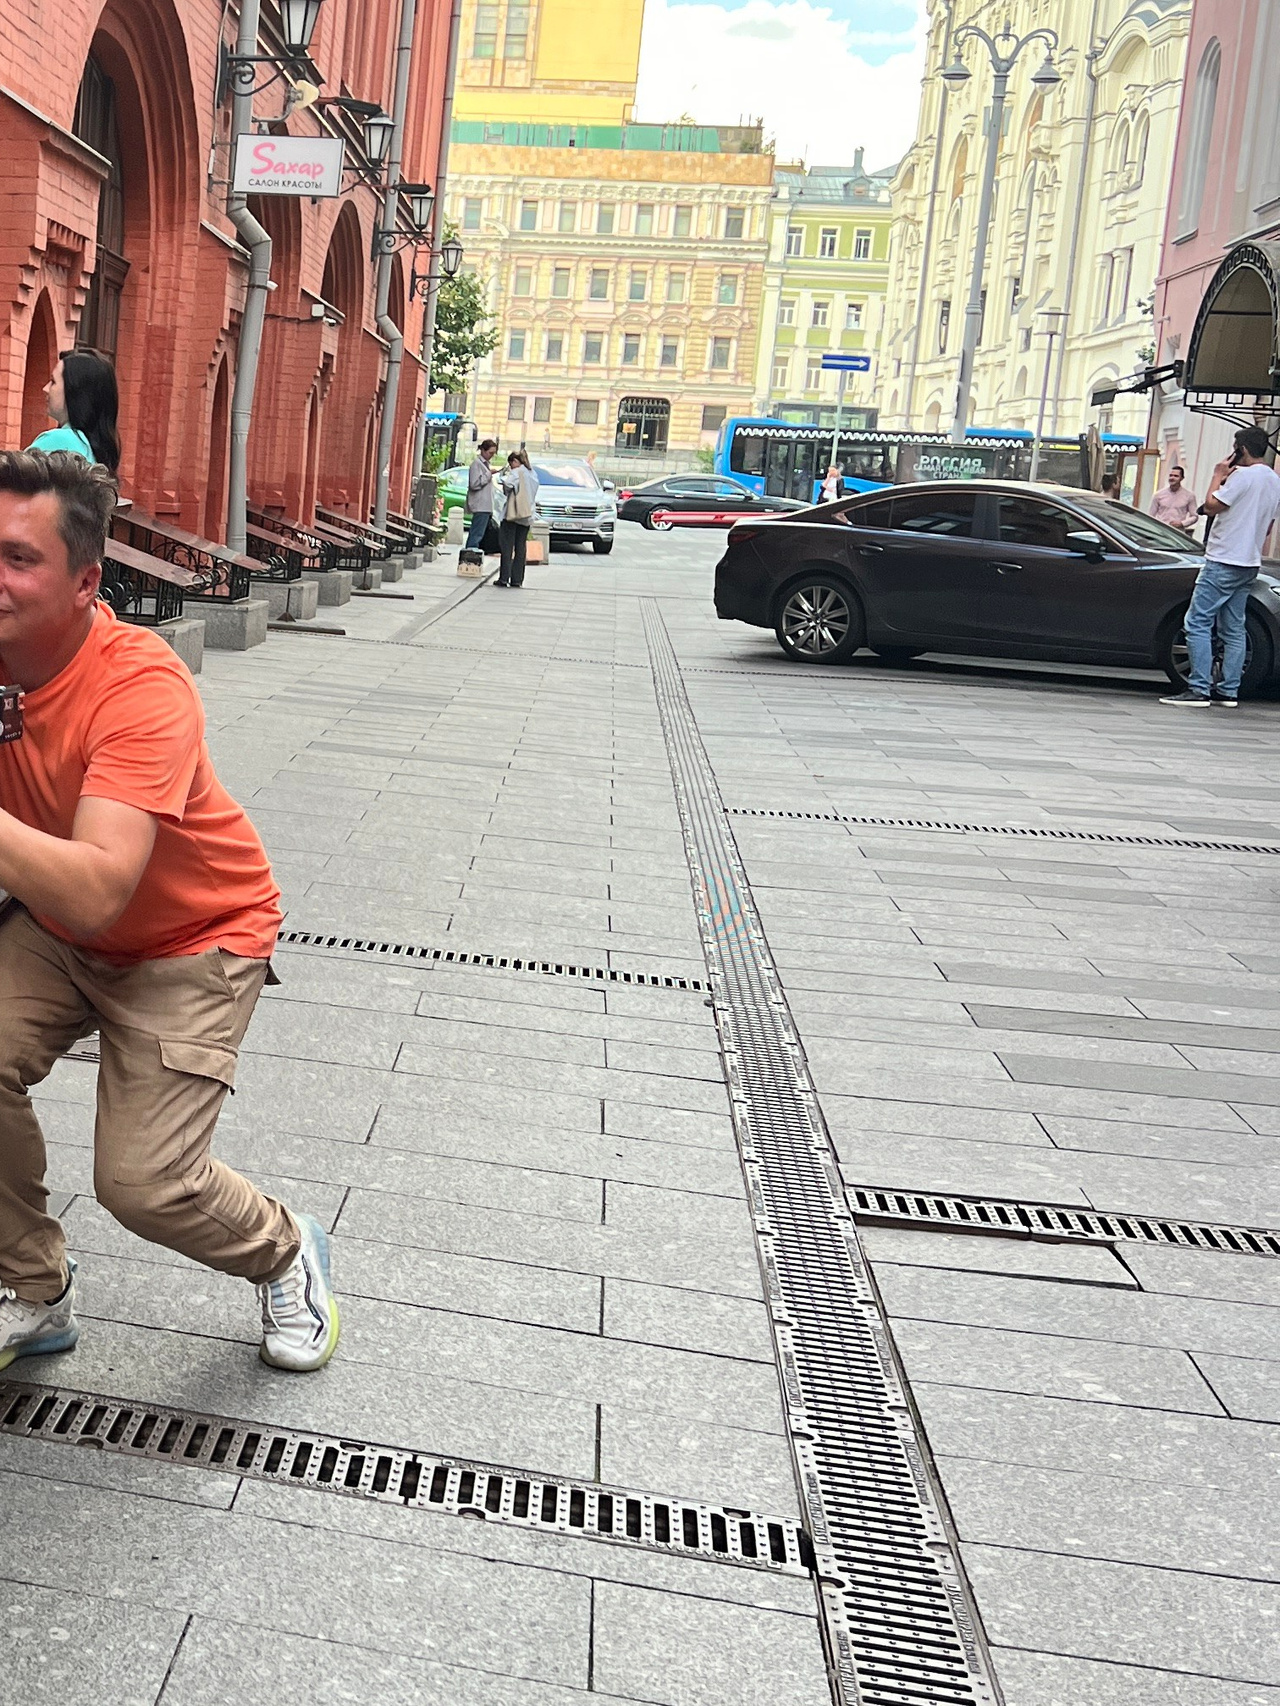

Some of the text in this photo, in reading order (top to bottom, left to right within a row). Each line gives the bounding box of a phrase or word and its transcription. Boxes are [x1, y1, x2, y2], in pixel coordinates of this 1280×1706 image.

[248, 178, 322, 189] САЛОН КРАСОТЫ
[913, 463, 940, 472] САМАЯ
[920, 455, 982, 470] РОССИЯ
